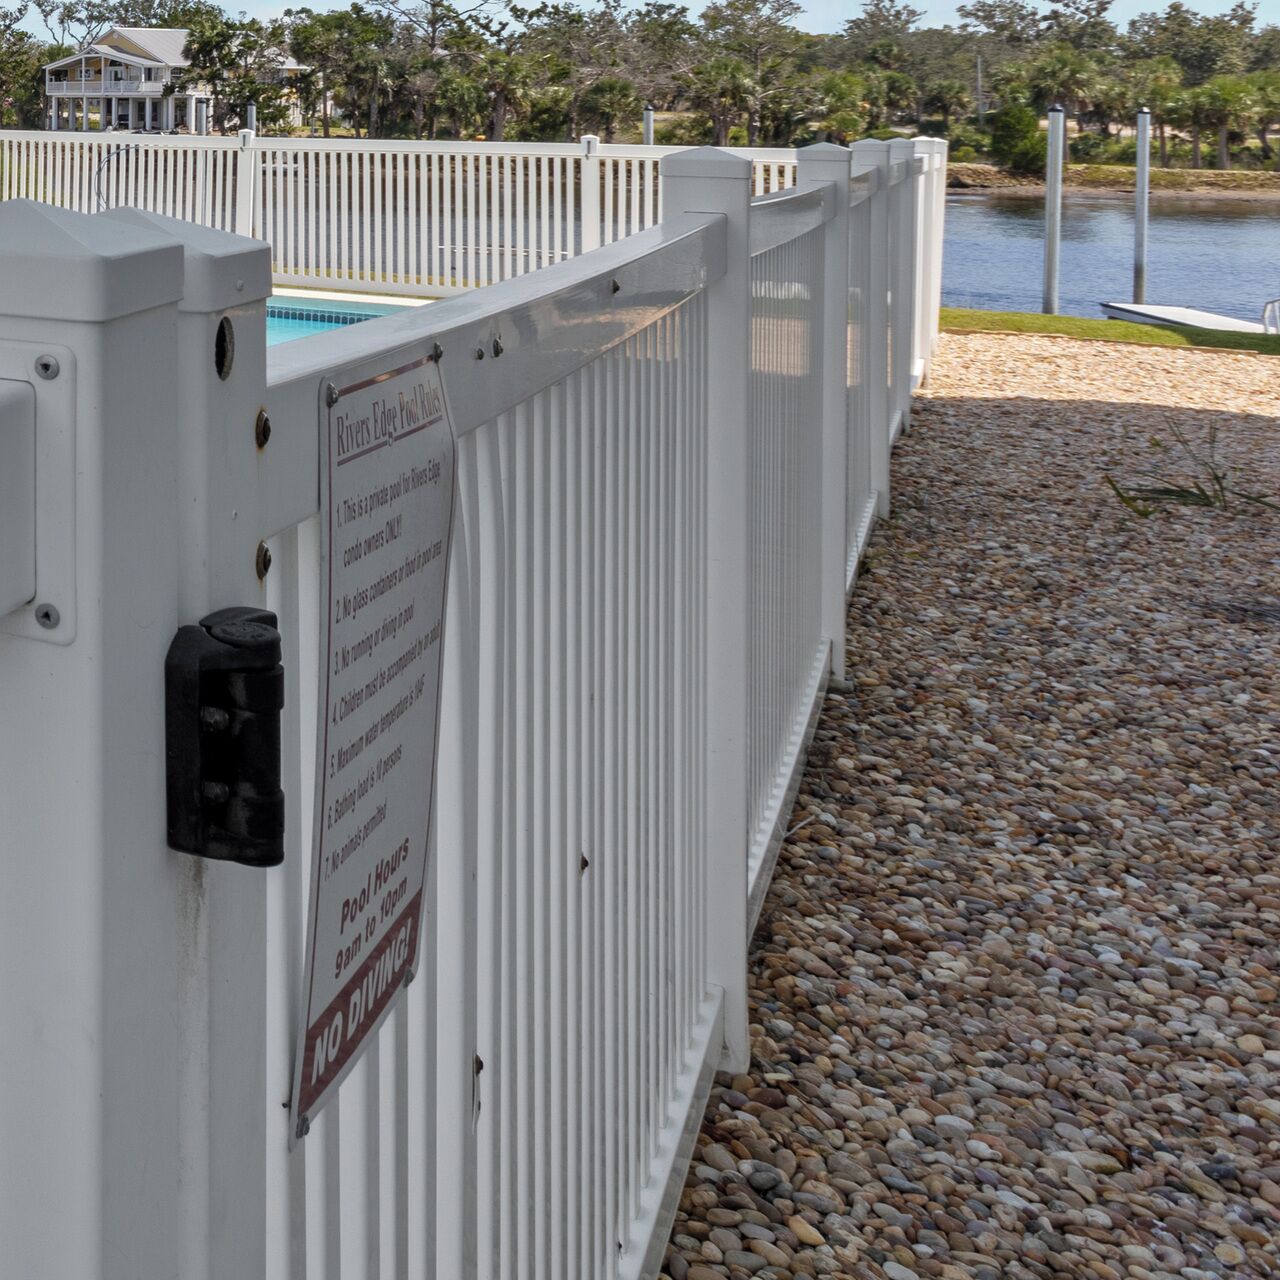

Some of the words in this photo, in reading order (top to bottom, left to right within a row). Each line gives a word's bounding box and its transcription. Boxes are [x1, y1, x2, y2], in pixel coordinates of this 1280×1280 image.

[337, 412, 370, 456] Rivers
[372, 399, 397, 447] Edge
[399, 386, 419, 429] Pool
[418, 380, 441, 420] Rules
[337, 503, 342, 528] 1.
[343, 496, 356, 524] This
[357, 493, 363, 517] is
[364, 497, 368, 514] a
[370, 484, 388, 518] private
[389, 474, 402, 508] pool
[402, 472, 411, 495] for
[410, 466, 427, 490] Rivers
[428, 458, 441, 488] Edge
[336, 600, 341, 624] 2.
[342, 594, 351, 620] No
[352, 587, 368, 620] glass
[370, 570, 397, 602] containers
[397, 565, 404, 583] or
[403, 552, 416, 578] food
[416, 549, 422, 571] in
[421, 547, 433, 573] pool
[432, 538, 442, 559] area
[344, 537, 362, 567] condo
[363, 530, 384, 556] owners
[385, 514, 402, 544] ONLY!
[334, 651, 340, 676] 3.
[342, 644, 350, 671] No
[351, 631, 373, 658] running
[374, 628, 380, 647] or
[381, 615, 397, 639] diving
[398, 607, 403, 630] in
[403, 596, 415, 631] pool
[333, 703, 338, 726] 4.
[340, 688, 364, 721] Children
[364, 670, 379, 702] must
[379, 667, 386, 690] be
[386, 637, 416, 684] accompanied
[330, 753, 335, 779] 5.
[337, 735, 364, 773] Maximum
[364, 720, 380, 748] water
[380, 694, 409, 735] temperature
[408, 686, 414, 707] is
[328, 806, 333, 830] 6.
[335, 788, 356, 824] Bathing
[357, 769, 369, 802] load
[370, 767, 375, 789] is
[382, 743, 402, 783] persons
[325, 856, 330, 881] 7.
[331, 849, 340, 875] No
[341, 825, 362, 865] animals
[362, 796, 388, 848] permitted
[335, 933, 362, 980] 9am
[365, 915, 377, 943] to
[380, 876, 407, 924] 10pm
[340, 872, 372, 936] Pool
[374, 836, 410, 896] Hours
[311, 1010, 344, 1086] NO
[346, 916, 413, 1042] DIVING!
